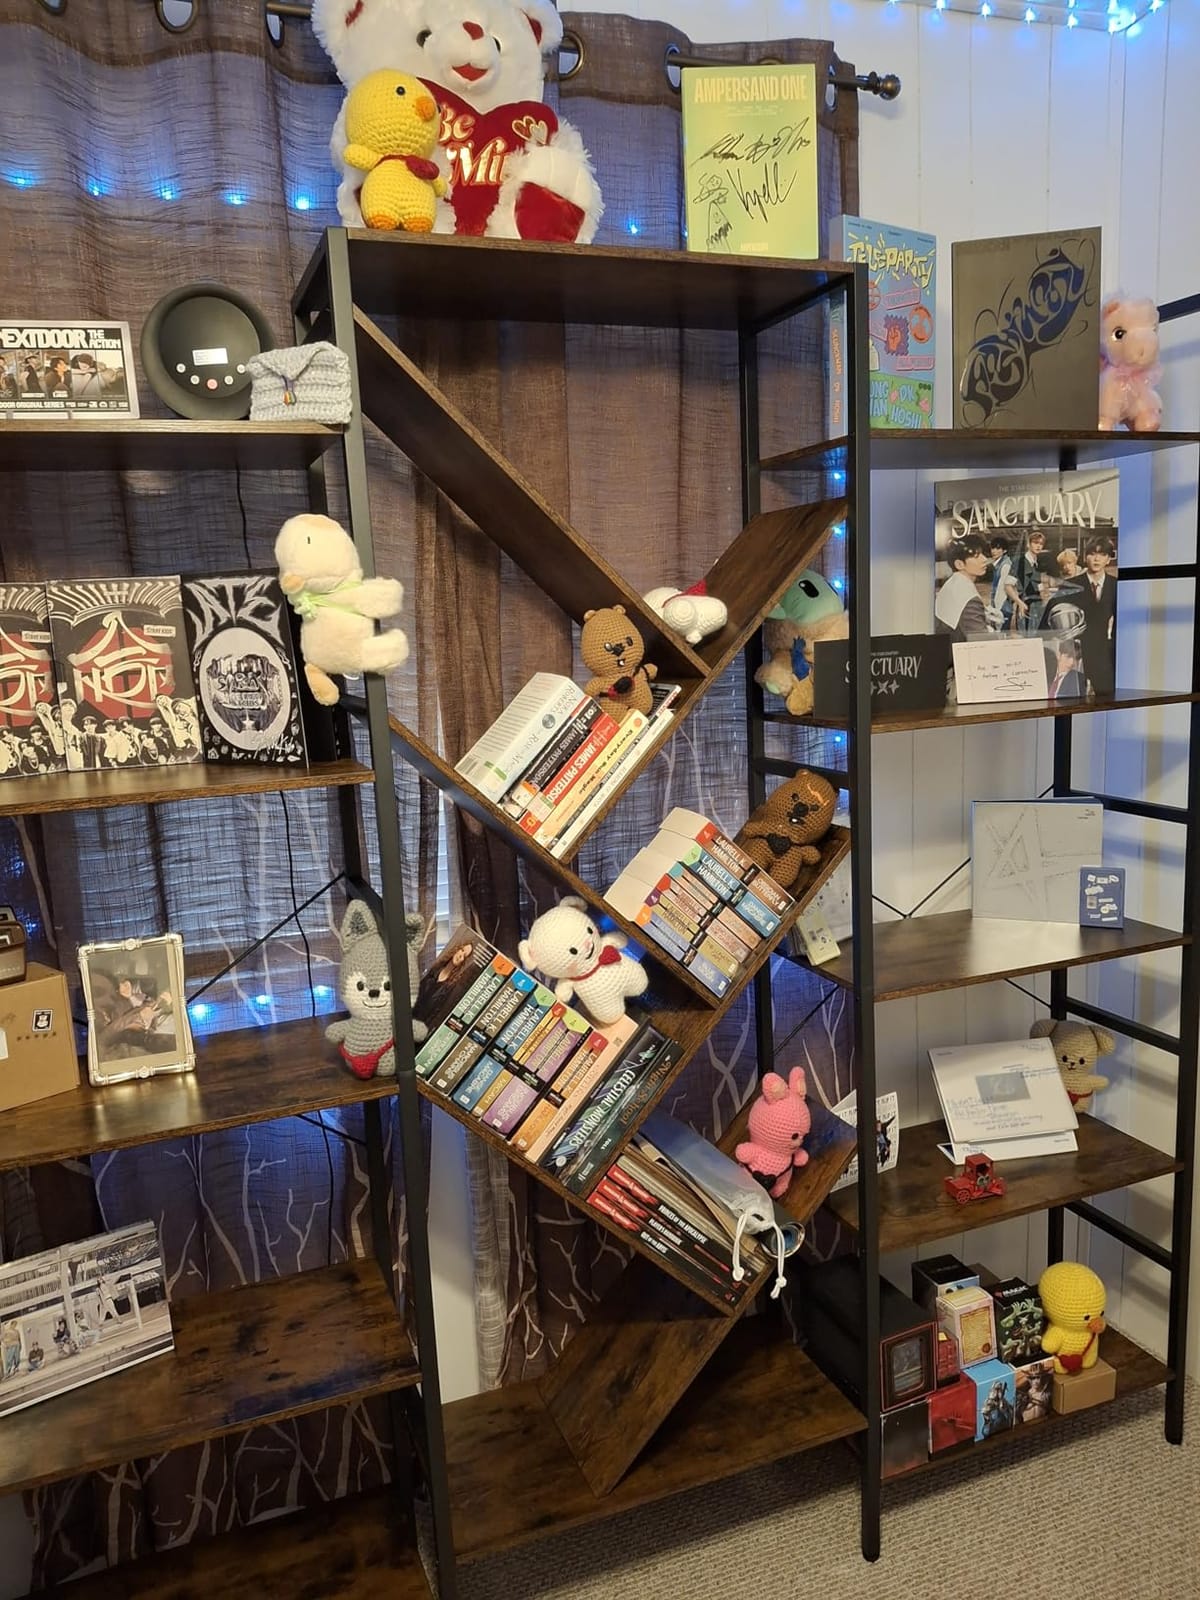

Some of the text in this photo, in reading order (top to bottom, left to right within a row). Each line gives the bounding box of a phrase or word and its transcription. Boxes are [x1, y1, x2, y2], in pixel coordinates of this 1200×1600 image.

[695, 75, 807, 104] AMPERSAND ONE
[439, 101, 475, 142] Be
[446, 137, 508, 187] Mi
[849, 244, 934, 289] TELEPARTY
[0, 328, 104, 349] EXTDOOR THE
[89, 339, 121, 349] ACTION
[951, 491, 1102, 539] SANCTUARY
[527, 726, 578, 787] JAMES PATTERSON
[572, 741, 597, 770] JAMES
[604, 727, 633, 761] Everyday
[545, 764, 579, 803] PATTERSO
[710, 844, 740, 873] HAMILTON
[715, 835, 742, 861] LAURELL
[696, 864, 728, 896] HAMILTON
[701, 855, 730, 882] LAURELL
[457, 970, 491, 1013] HAMILTON
[470, 975, 501, 1013] LAURELL
[479, 984, 513, 1027] HAMILTON
[492, 988, 522, 1026] LAURELL
[500, 1002, 534, 1044] HAMILTON
[515, 1007, 543, 1042] LAURELL
[530, 1025, 564, 1068] HAMILTON
[546, 1031, 575, 1067] LAURELL
[570, 1051, 598, 1086] LAURELL
[600, 1067, 636, 1110] CELESTIAL
[567, 1104, 607, 1152] MONSTERS
